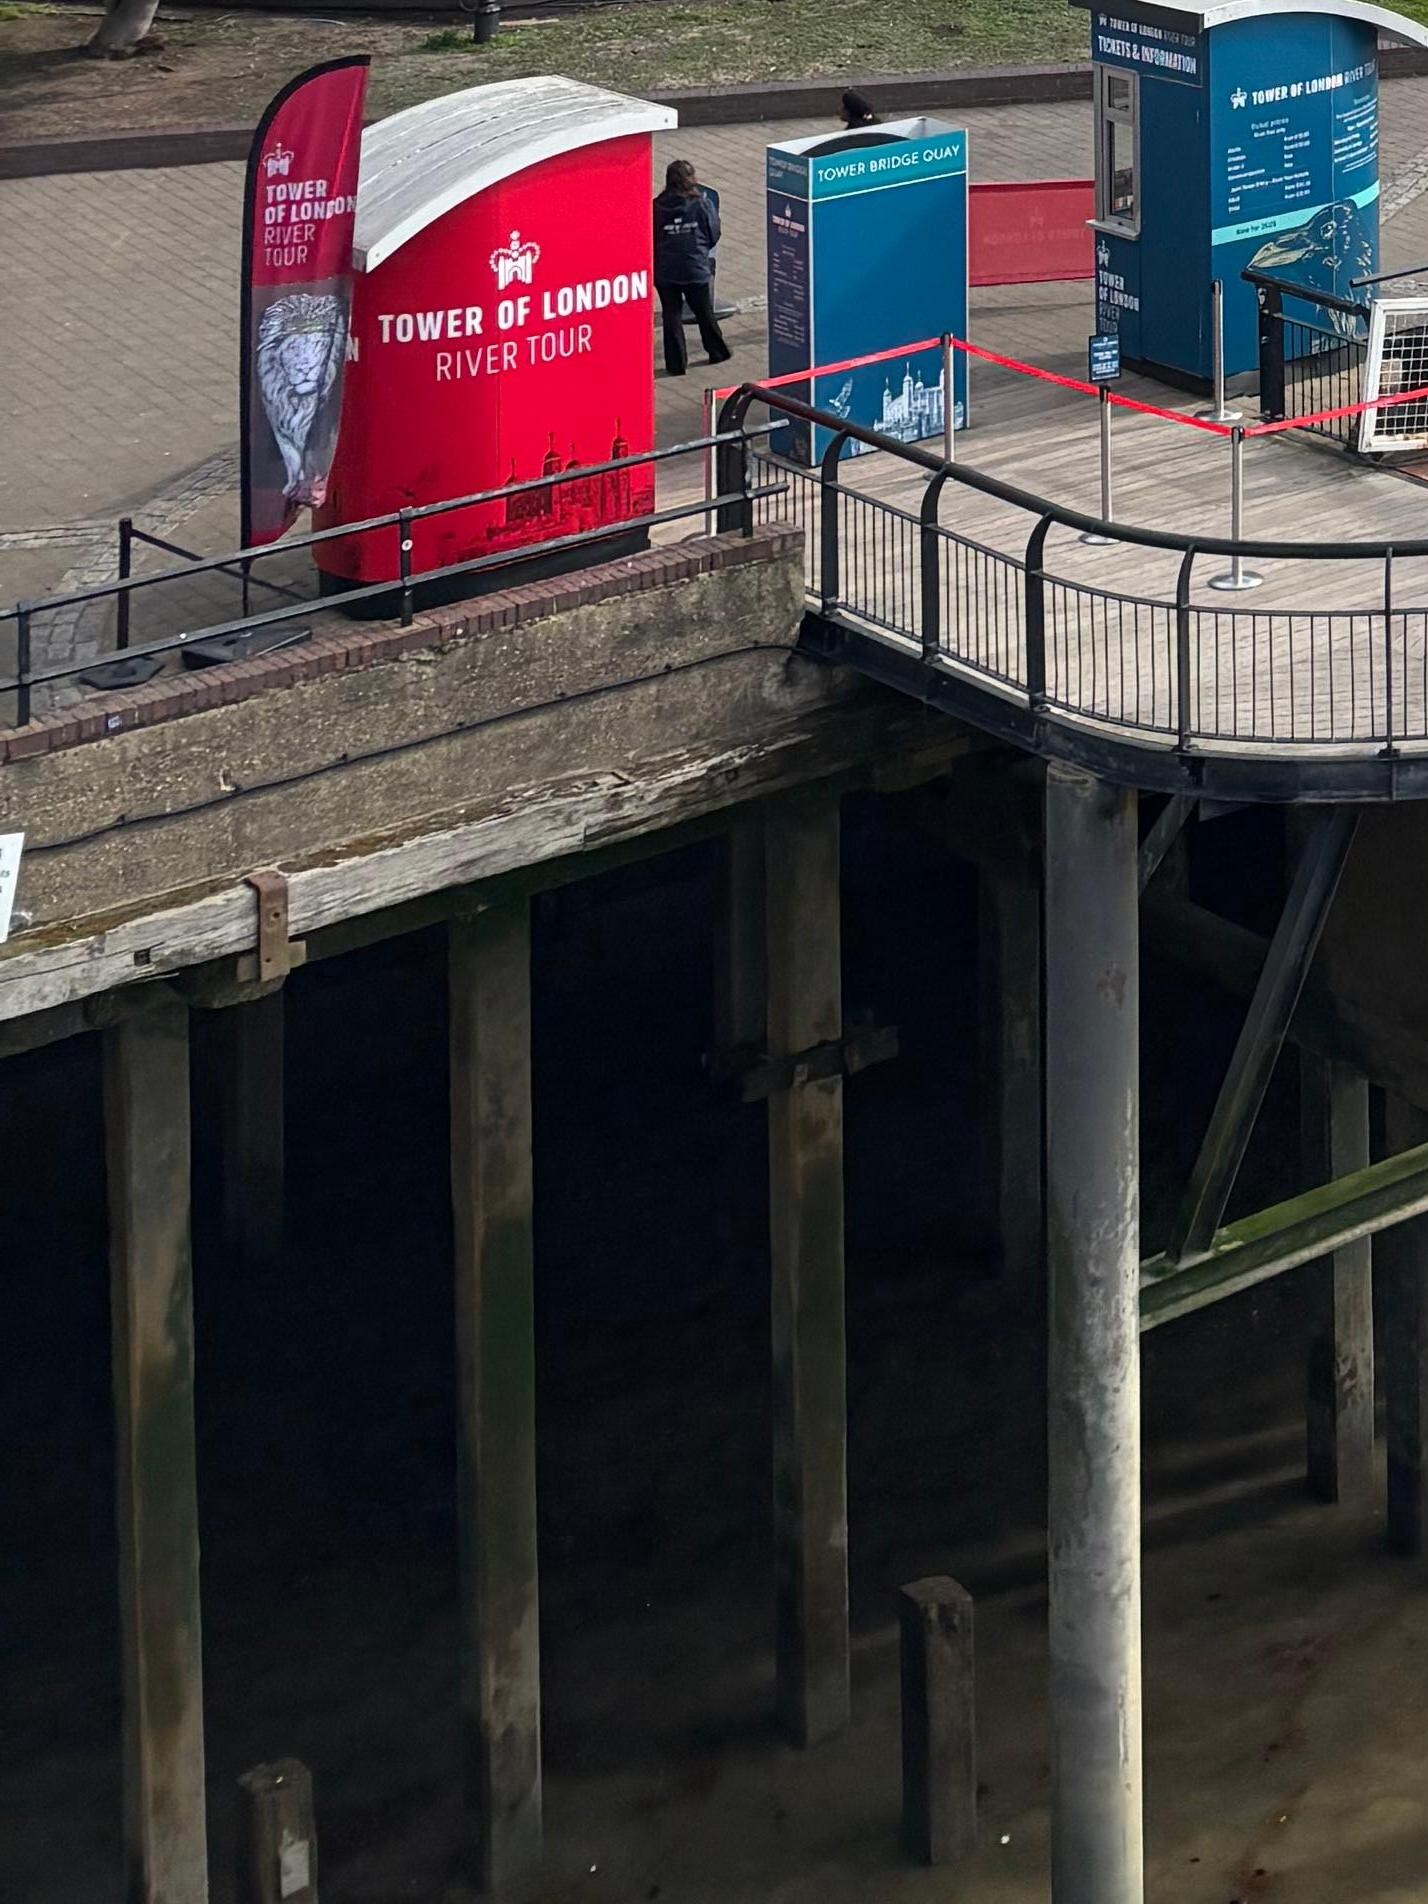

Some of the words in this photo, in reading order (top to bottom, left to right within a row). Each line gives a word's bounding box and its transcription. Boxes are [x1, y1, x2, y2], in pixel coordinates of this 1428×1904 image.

[1098, 35, 1131, 58] TICKETS
[1132, 43, 1141, 60] &
[1141, 45, 1197, 74] INFORMATION
[1252, 85, 1288, 106] TOWER
[1290, 82, 1303, 98] OF
[1306, 72, 1344, 94] LONDON
[818, 165, 866, 183] TOWER
[869, 152, 919, 173] BRIDGE
[922, 145, 960, 162] QUAY
[265, 179, 328, 204] TOWER
[264, 204, 286, 225] OF
[290, 194, 357, 223] LONDON
[264, 224, 316, 245] RIVER
[264, 247, 308, 267] TOUR
[1099, 271, 1124, 290] TOWER
[377, 306, 484, 344] TOWER
[497, 295, 532, 331] OF
[543, 270, 648, 320] LONDON
[1099, 286, 1108, 301] OF
[1109, 292, 1140, 312] LONDON
[435, 341, 518, 382] RIVER
[526, 324, 593, 366] TOUR
